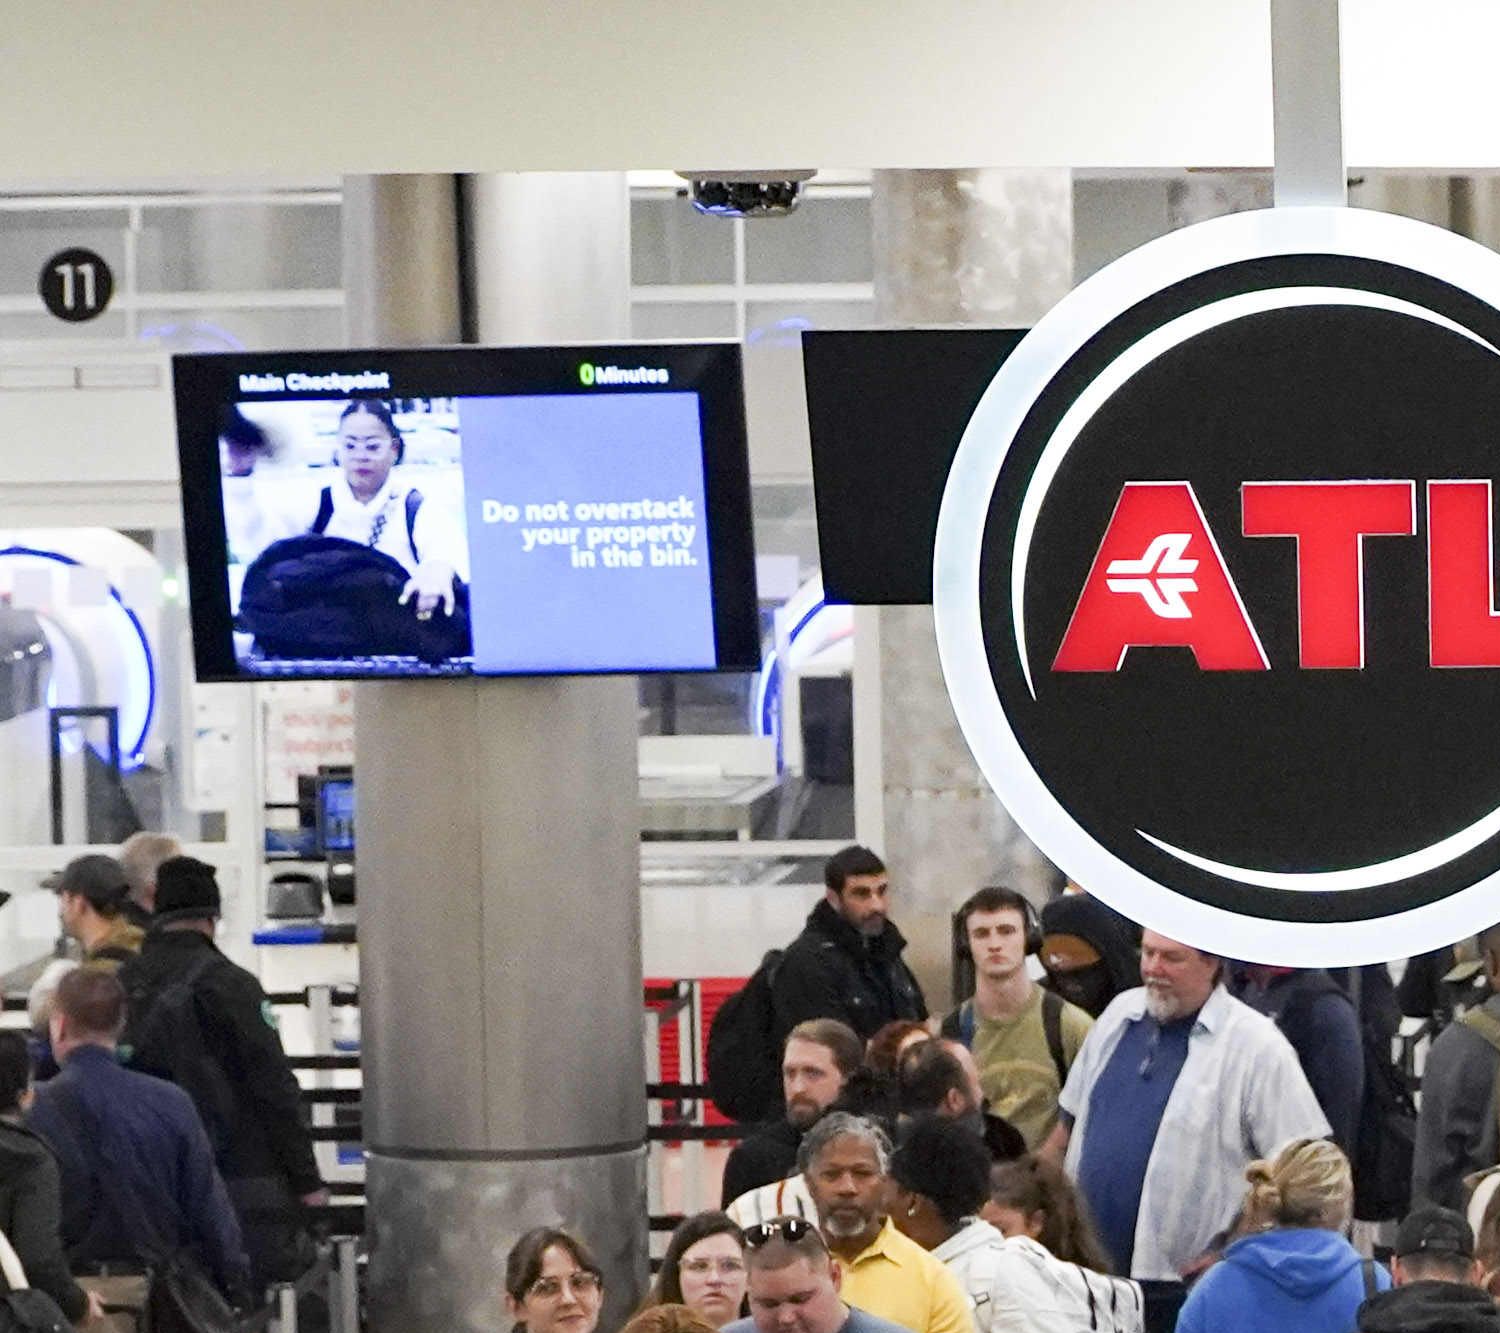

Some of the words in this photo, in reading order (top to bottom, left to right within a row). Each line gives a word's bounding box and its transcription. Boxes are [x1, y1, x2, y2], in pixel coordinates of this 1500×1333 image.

[54, 263, 96, 310] 11
[595, 365, 669, 385] Minutes
[482, 500, 520, 523] Do
[525, 499, 569, 522] not
[575, 496, 695, 522] overstack
[522, 526, 580, 552] your
[587, 523, 697, 552] property
[571, 546, 595, 569] in
[602, 543, 643, 568] the
[650, 541, 698, 568] bin.
